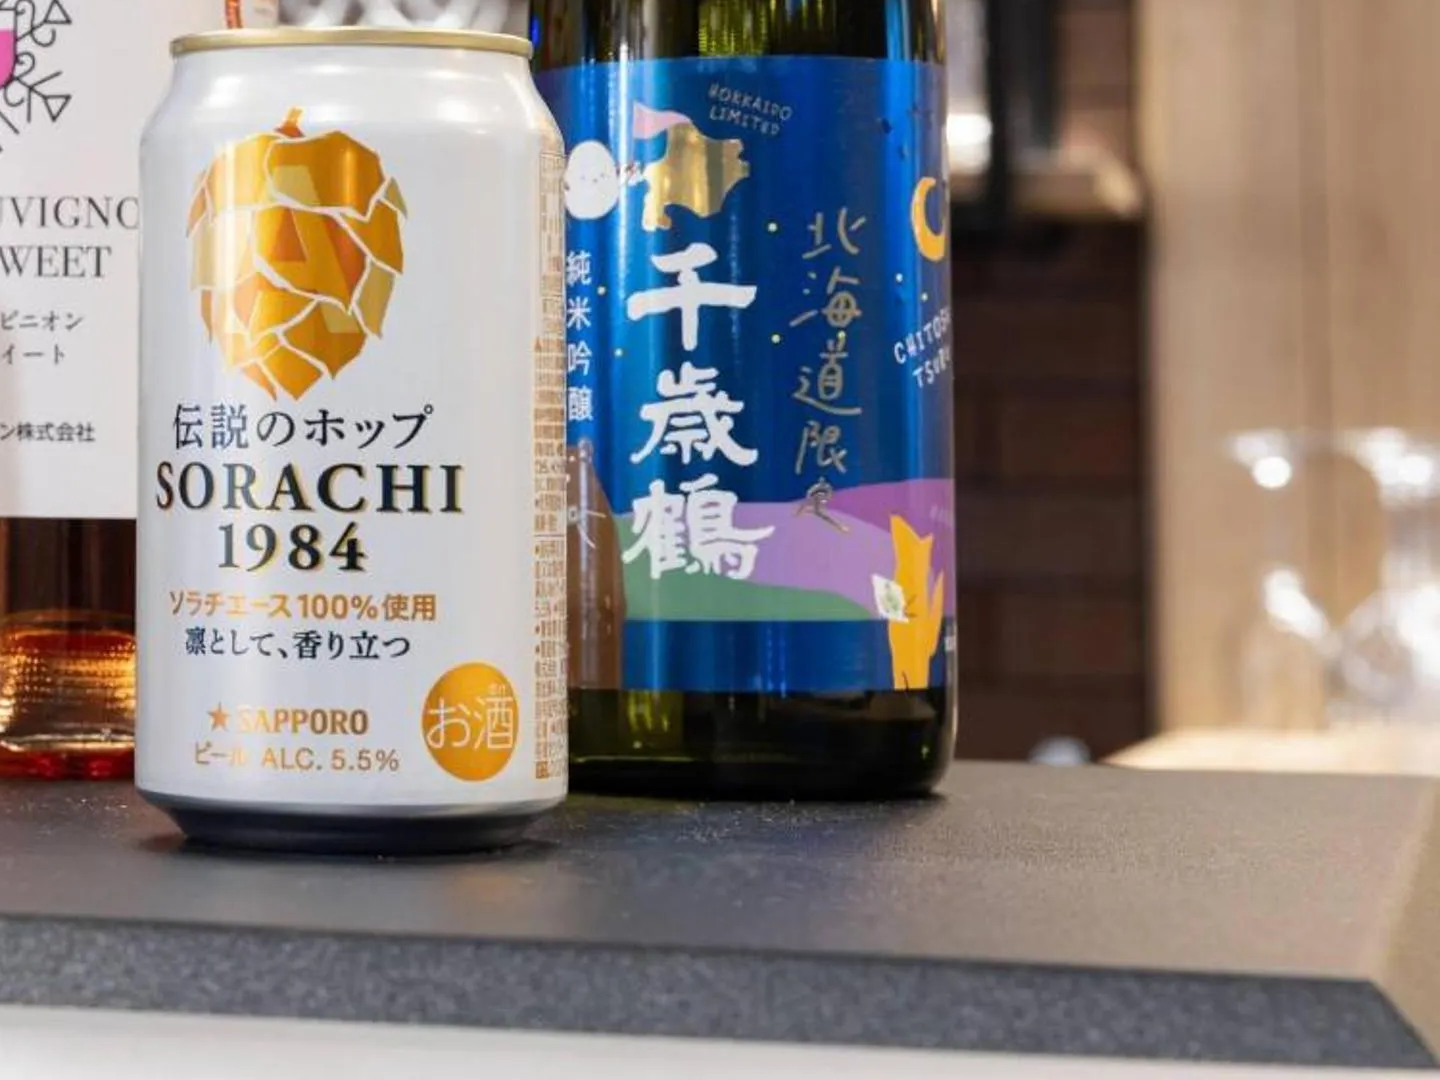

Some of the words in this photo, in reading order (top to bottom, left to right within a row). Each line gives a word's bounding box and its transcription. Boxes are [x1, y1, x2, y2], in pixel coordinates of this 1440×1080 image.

[708, 82, 793, 120] HOKKAIDO
[709, 105, 780, 135] LIMITED
[566, 250, 594, 421] 純米吟醸
[789, 207, 866, 533] 北海道限定
[173, 403, 435, 449] 伝説のホップ
[622, 242, 776, 581] 千歳鶴
[156, 461, 464, 514] SORACHI
[217, 521, 368, 572] 1984
[238, 706, 370, 736] SAPPORO
[426, 697, 515, 750] お酒
[262, 747, 323, 771] ALC.
[331, 748, 400, 772] 5.5%
